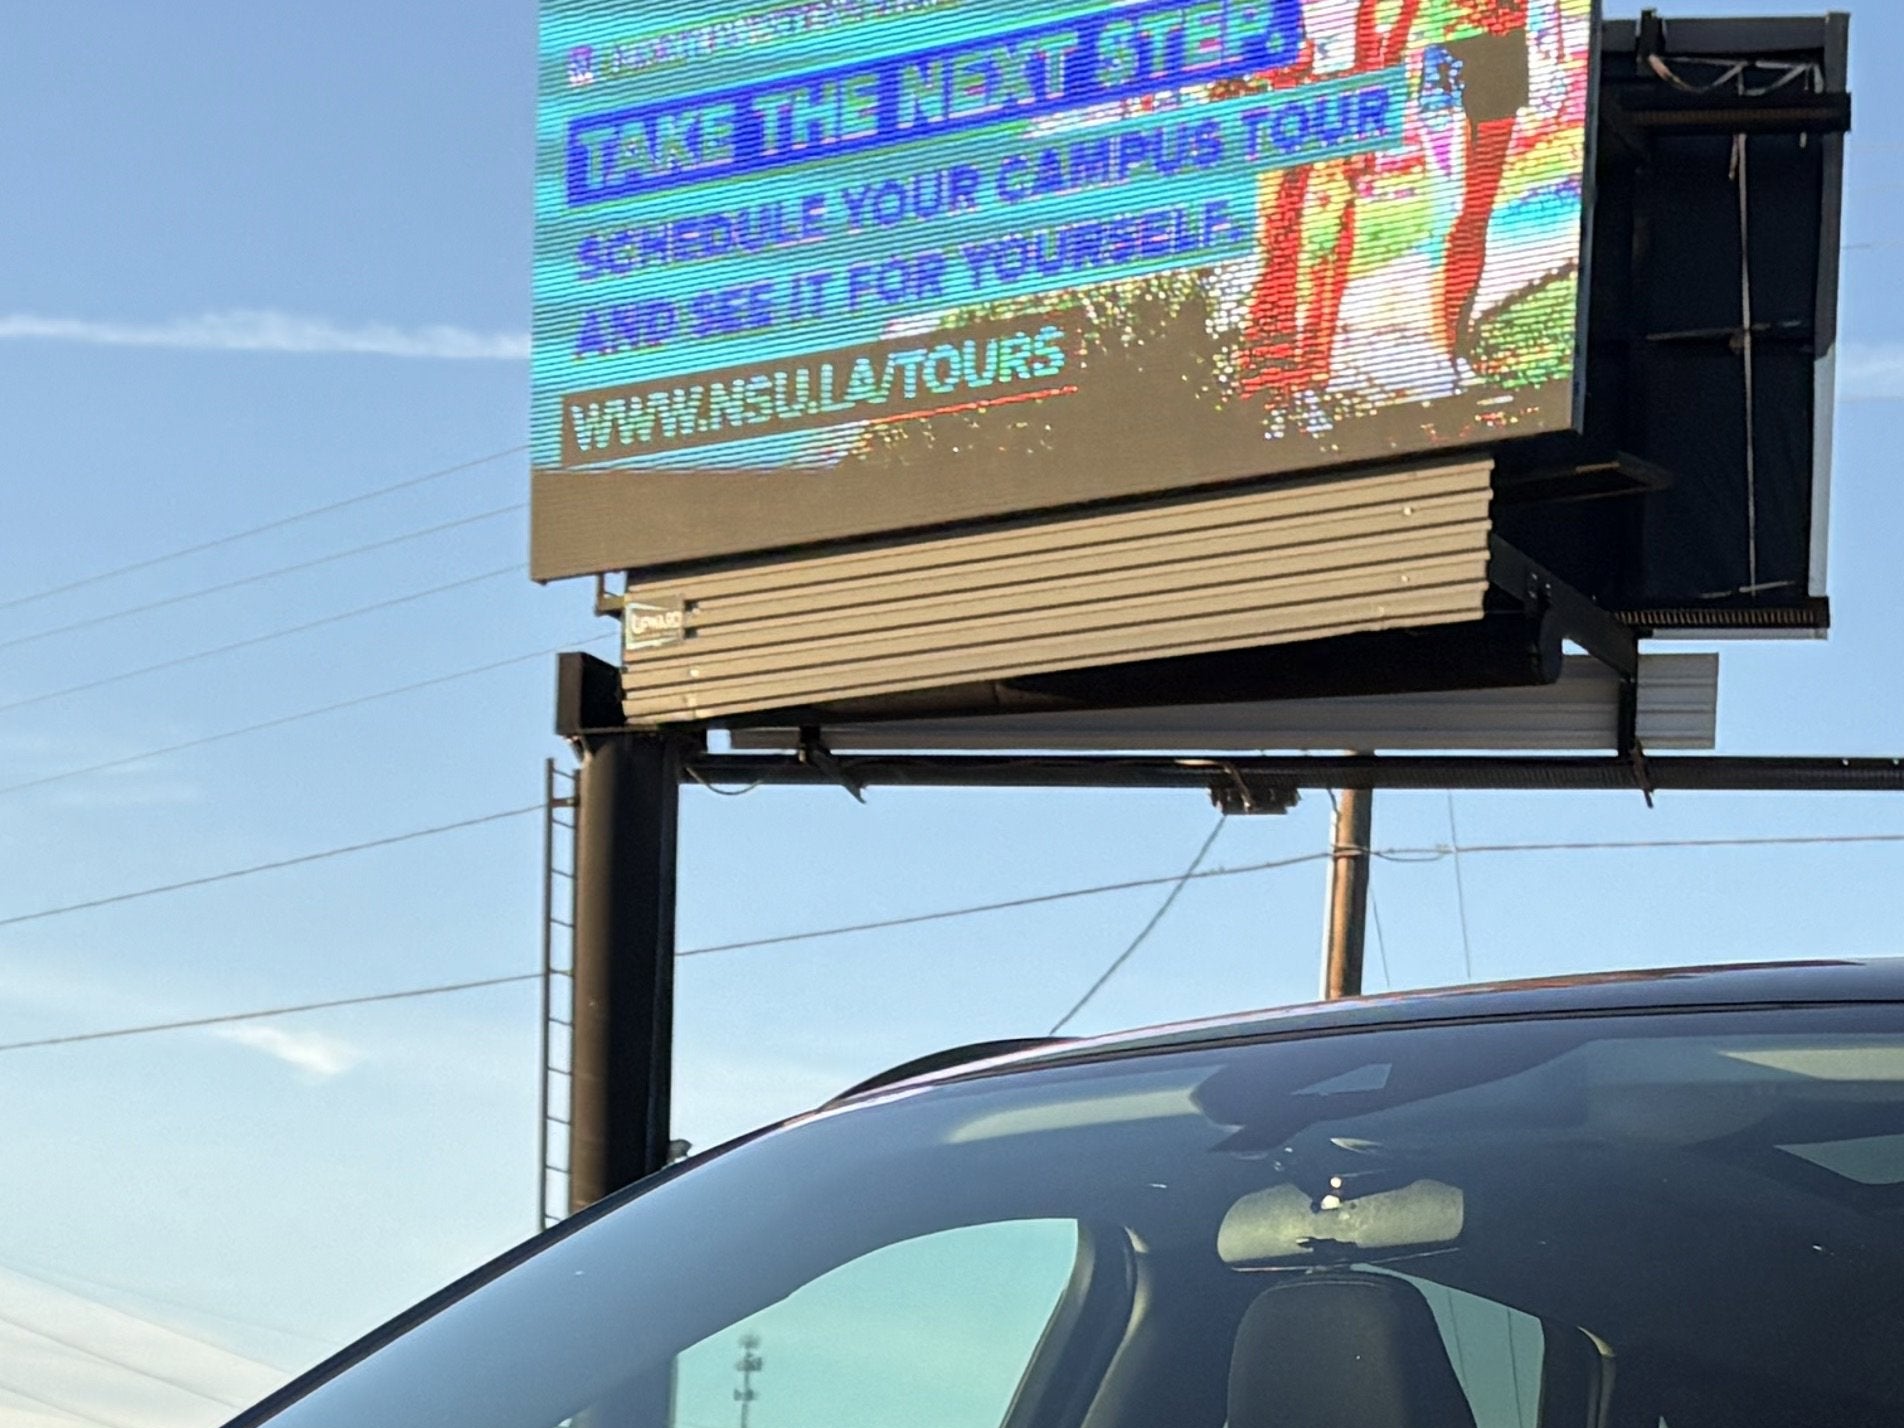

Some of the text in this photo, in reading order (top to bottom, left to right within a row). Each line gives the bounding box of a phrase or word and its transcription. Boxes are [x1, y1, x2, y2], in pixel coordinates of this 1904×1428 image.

[577, 104, 734, 192] TAKE
[753, 72, 880, 156] THE
[897, 33, 1079, 130] NEXT
[1098, 0, 1285, 87] STEP.
[577, 86, 1391, 282] SCHEDULE YOUR CAMPUS TOUR
[574, 199, 1244, 361] AND SEE IT FOR YOURSELF.
[571, 326, 1066, 451] WWW.NSU.LA/TOURS
